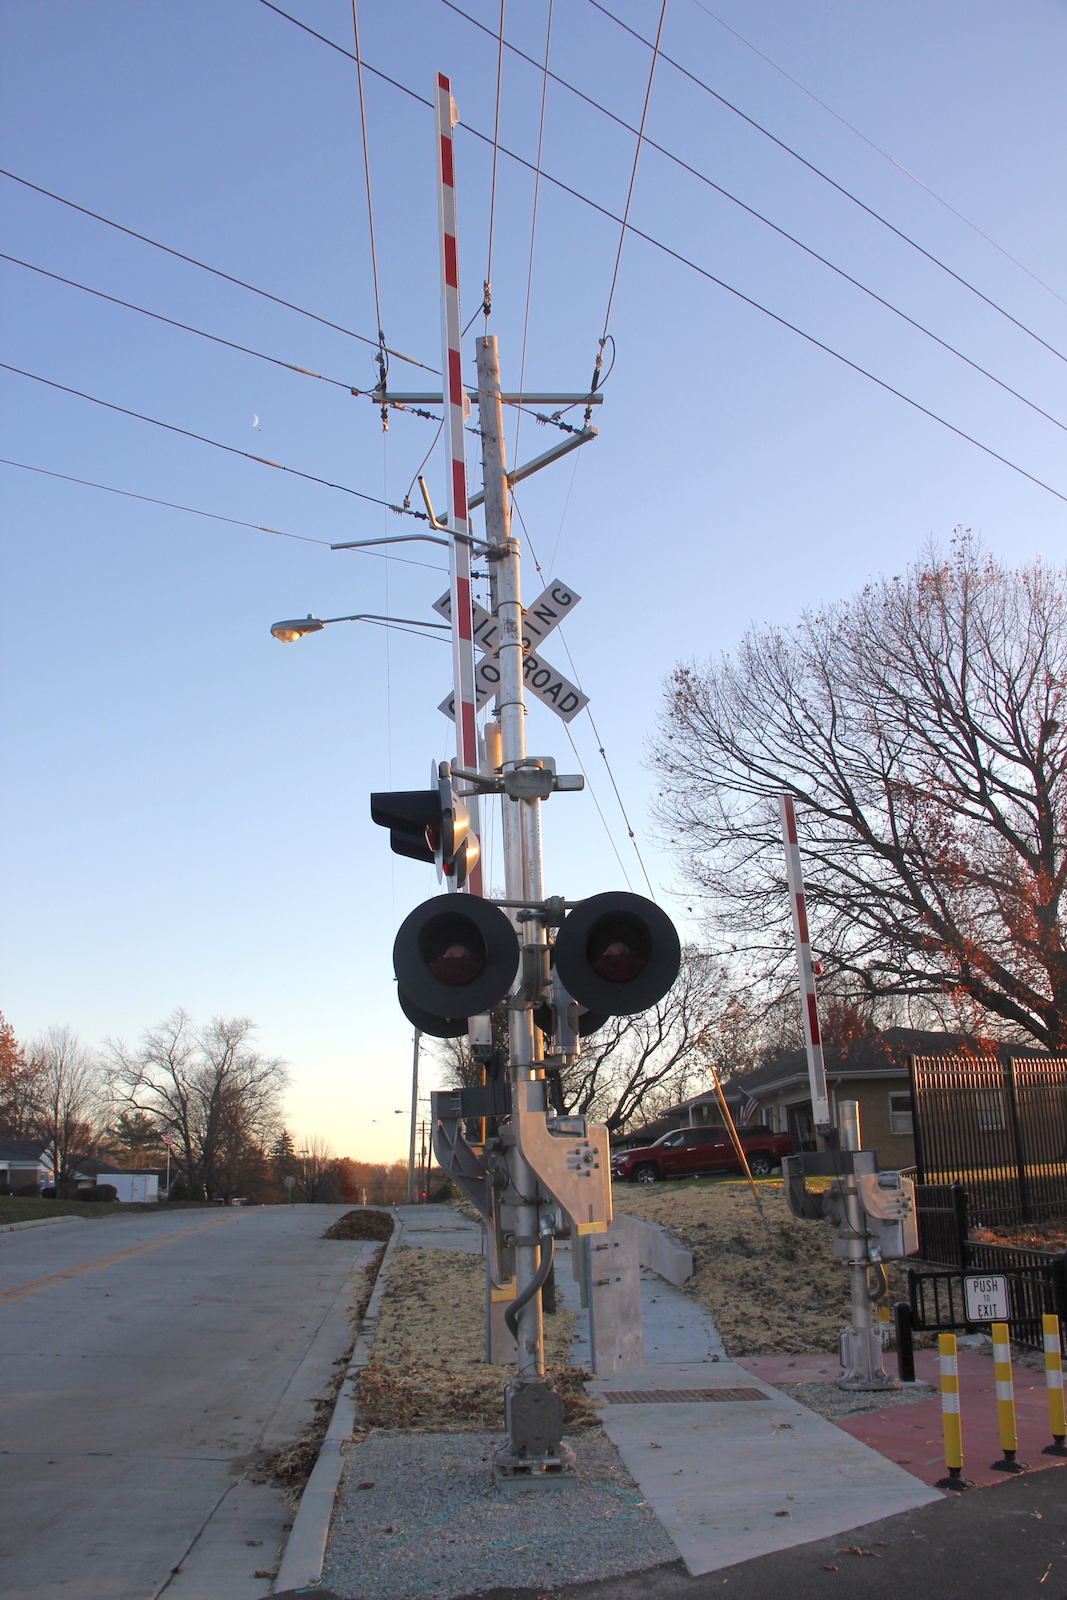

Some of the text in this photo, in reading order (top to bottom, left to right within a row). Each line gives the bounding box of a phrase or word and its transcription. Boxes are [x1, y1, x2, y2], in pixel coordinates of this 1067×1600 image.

[973, 1280, 998, 1292] PUSH
[983, 1294, 991, 1302] TO
[977, 1304, 997, 1317] EXIT
